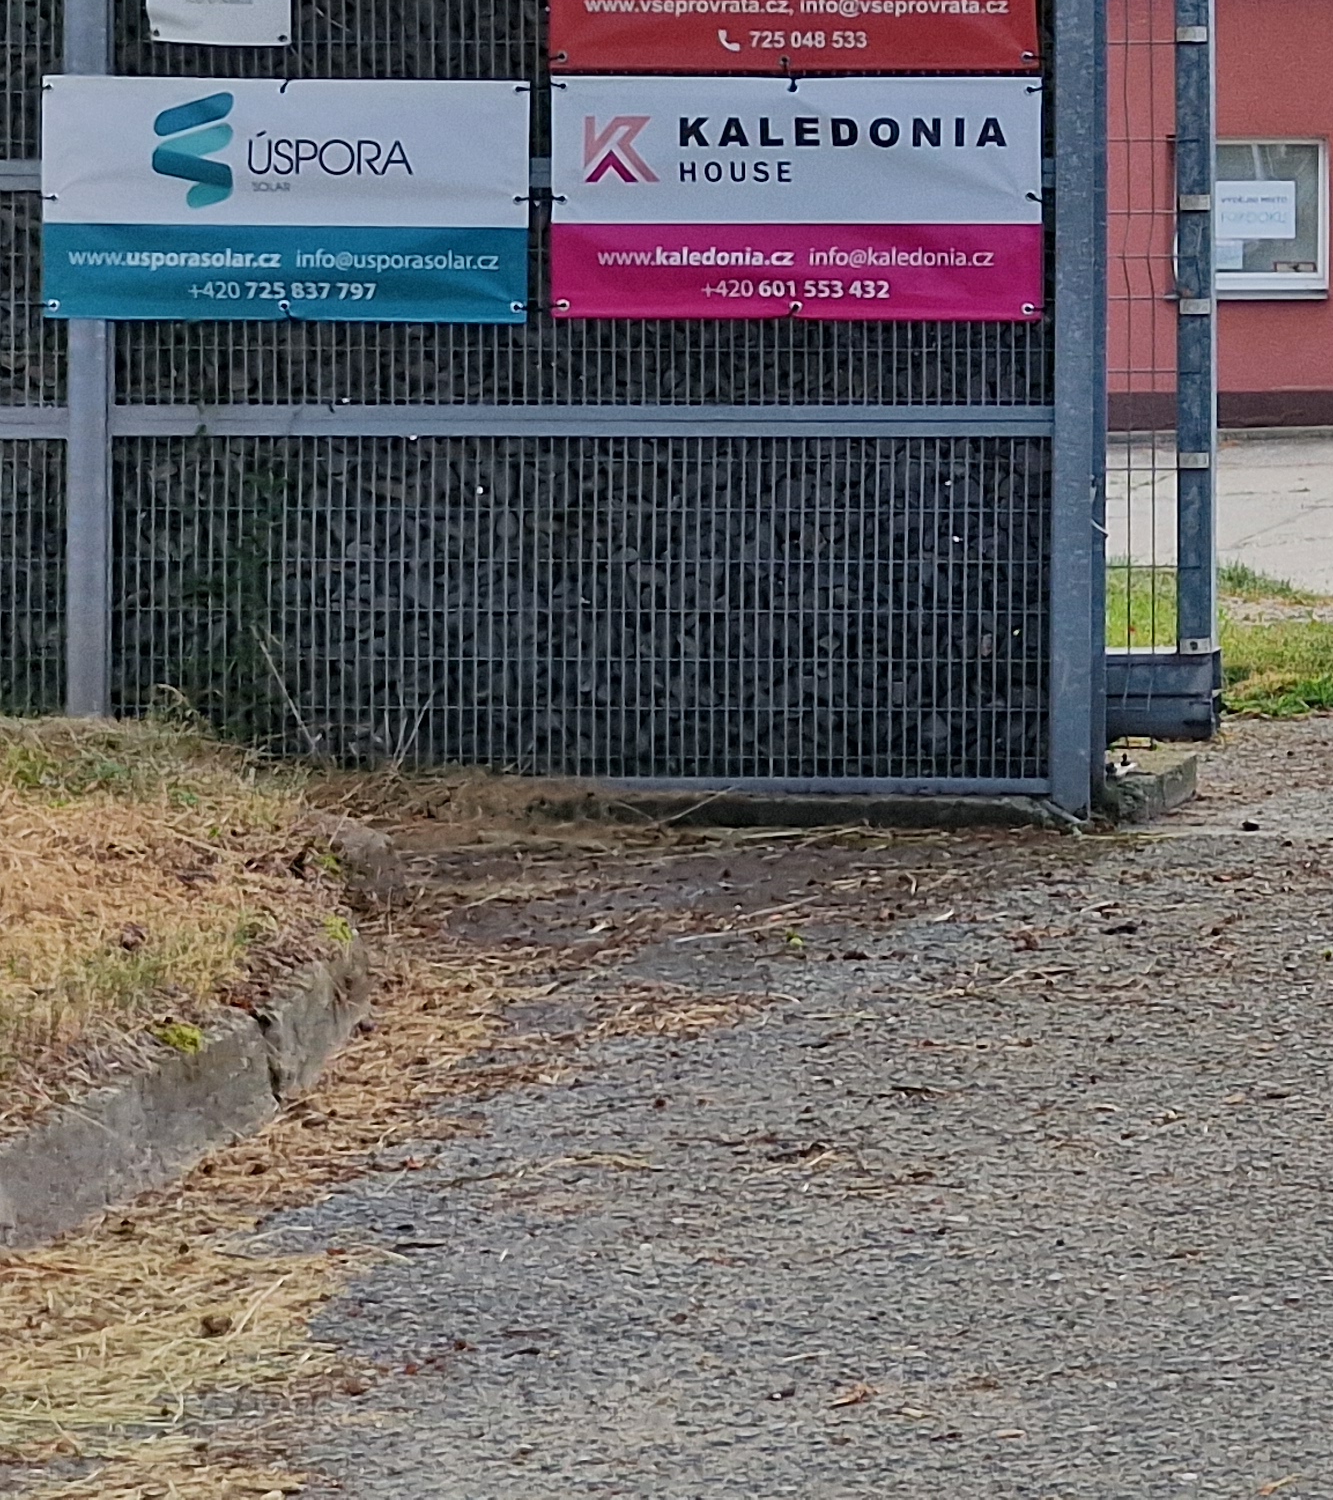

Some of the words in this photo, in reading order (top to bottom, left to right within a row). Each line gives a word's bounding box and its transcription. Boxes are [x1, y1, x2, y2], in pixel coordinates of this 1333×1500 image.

[749, 31, 785, 48] 725
[791, 31, 826, 48] 048
[832, 32, 867, 48] 533
[679, 117, 1007, 147] KALEDONIA
[247, 131, 413, 175] ÚSPORA
[680, 162, 792, 182] HOUSE
[252, 181, 291, 192] SOLAR
[69, 247, 282, 271] www.usporasolar.cz
[296, 249, 500, 273] info@usporasolar.cz
[598, 247, 794, 267] www.kaledonia.cz
[809, 248, 995, 270] info@kaledonia.cz
[189, 282, 241, 299] +420
[246, 282, 285, 299] 725
[291, 282, 333, 299] 837
[339, 282, 377, 299] 797
[701, 280, 753, 297] +420
[759, 279, 796, 297] 601
[804, 280, 844, 297] 553
[850, 280, 890, 298] 432
